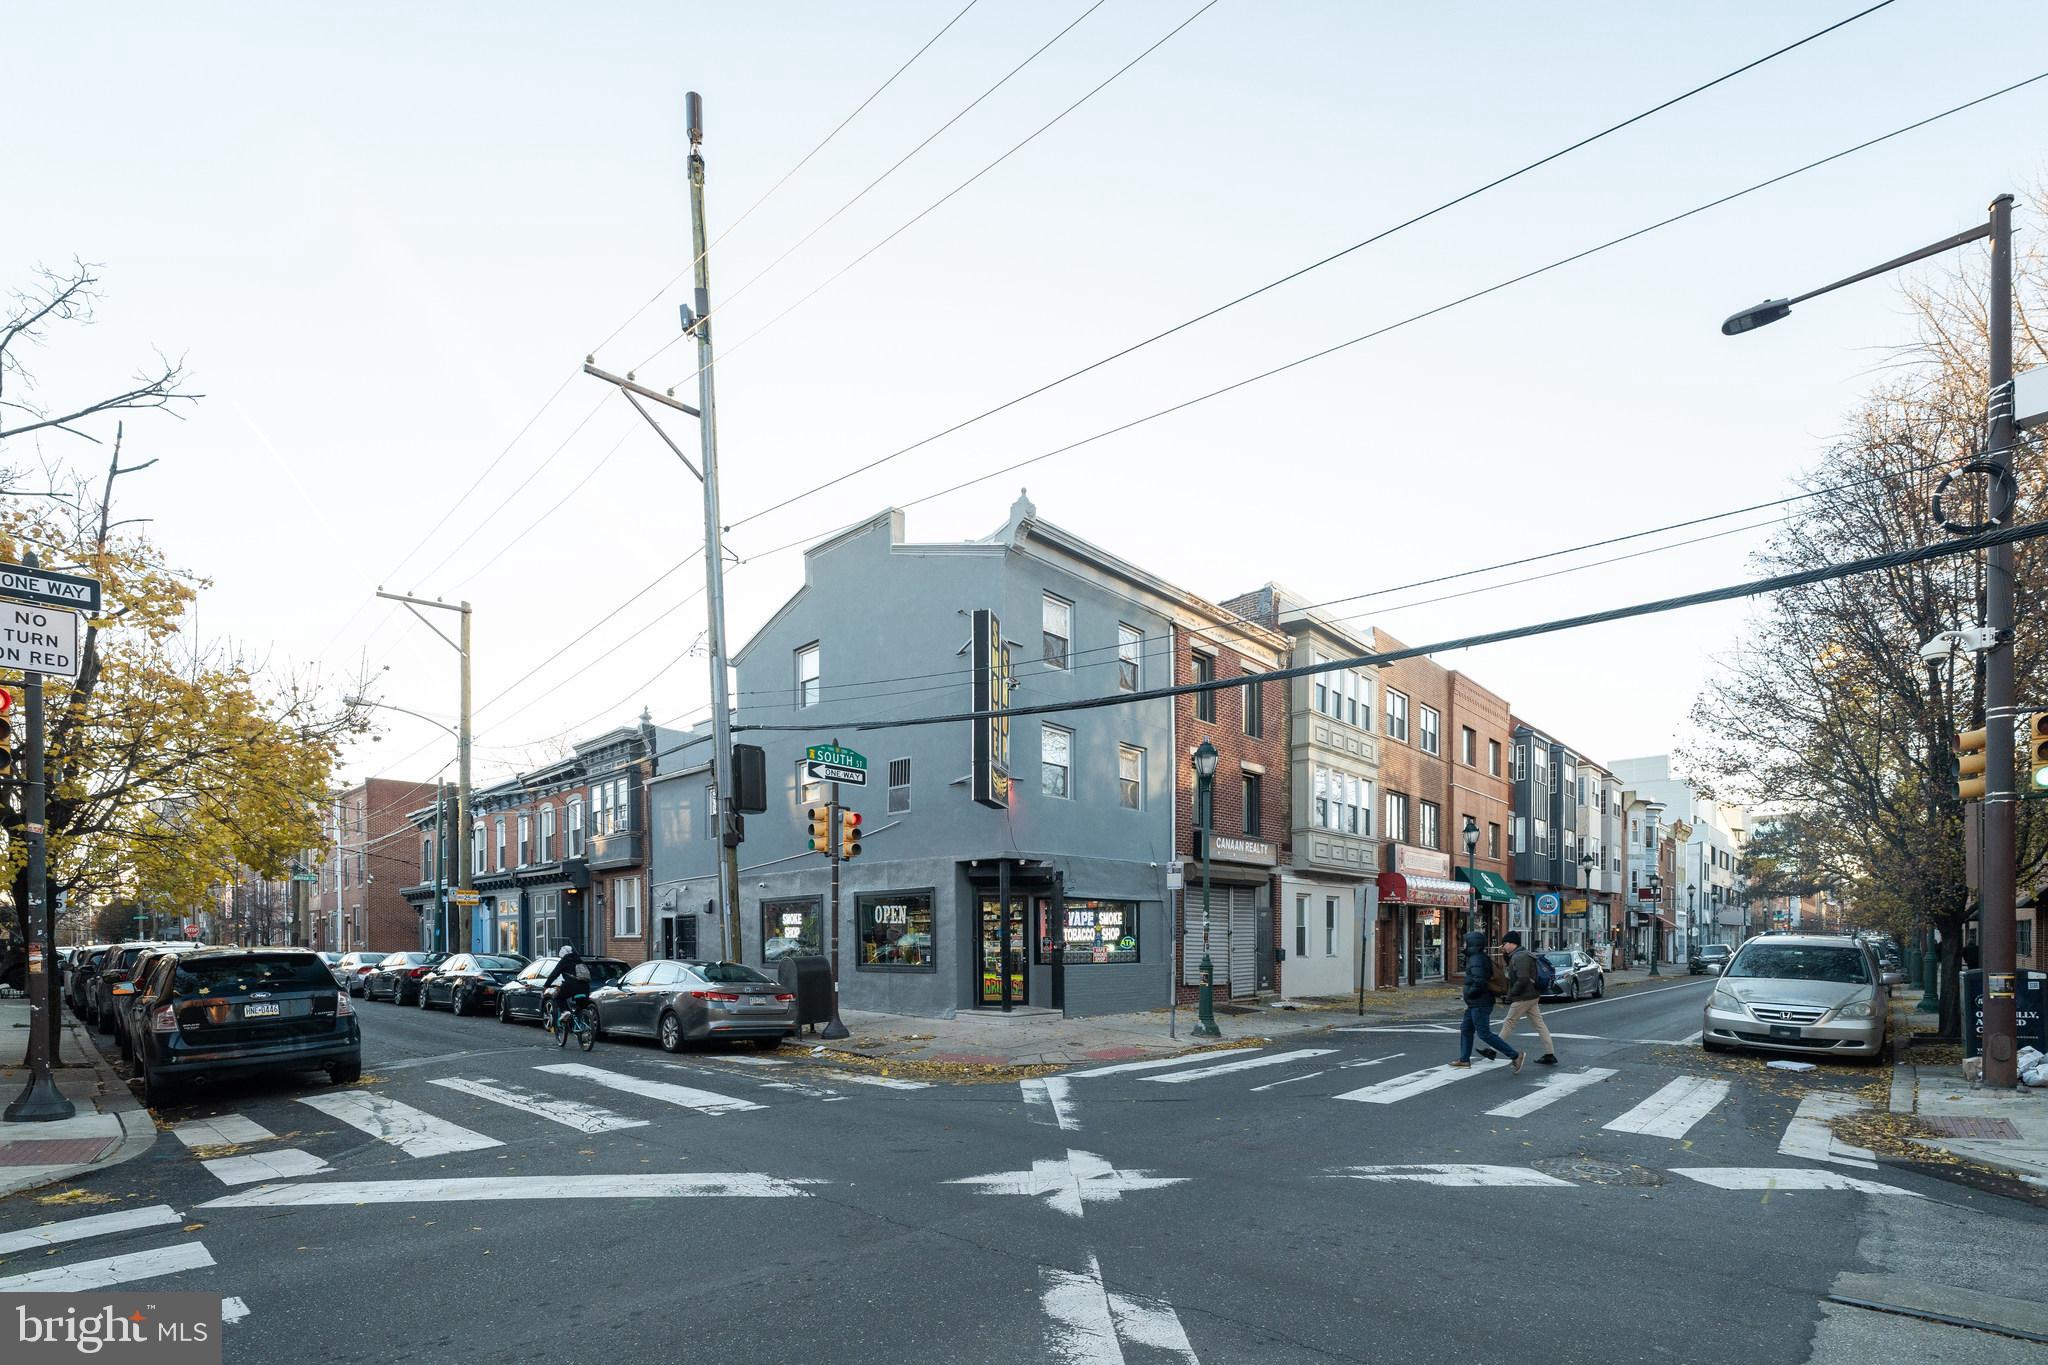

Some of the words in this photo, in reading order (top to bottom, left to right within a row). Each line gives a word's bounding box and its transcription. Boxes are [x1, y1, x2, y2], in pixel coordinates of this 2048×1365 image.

[2, 574, 40, 592] ONE
[47, 581, 85, 599] WAY
[15, 611, 47, 627] NO
[3, 629, 58, 648] TURN
[30, 651, 69, 667] RED
[817, 750, 853, 766] SOUTH
[825, 768, 841, 778] ONE
[843, 771, 861, 781] WAY
[1216, 837, 1244, 851] CANAAN
[1245, 841, 1269, 855] REALTY
[782, 913, 802, 925] SMOKE
[874, 905, 907, 924] OPEN
[1068, 911, 1094, 926] VAPE
[1098, 911, 1123, 925] SMOKE
[186, 926, 198, 934] STOP
[784, 926, 801, 939] SHOP
[1063, 927, 1095, 942] TOBACCO
[1101, 927, 1120, 940] SHOP
[1119, 939, 1136, 948] ATM
